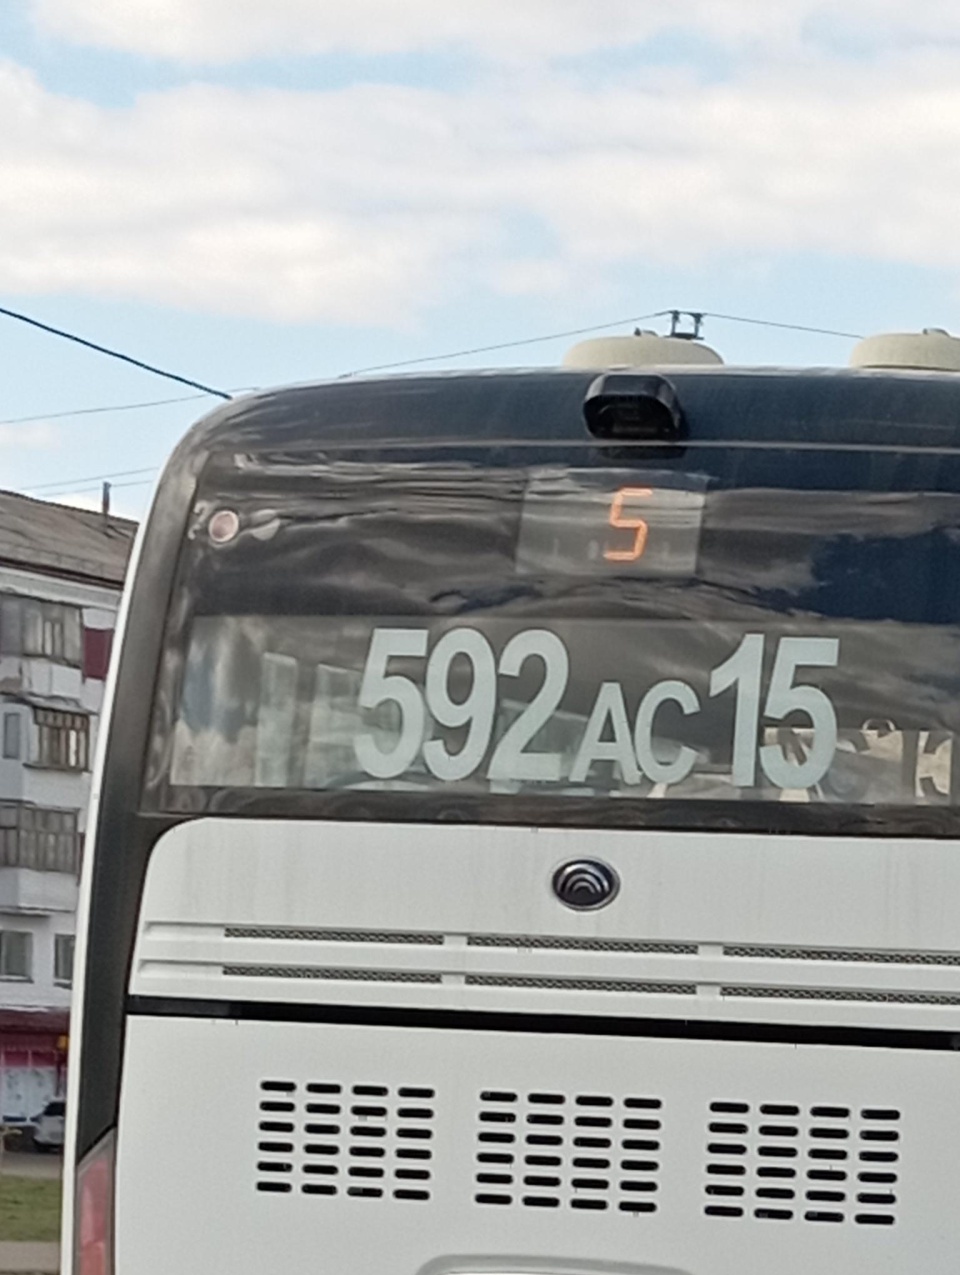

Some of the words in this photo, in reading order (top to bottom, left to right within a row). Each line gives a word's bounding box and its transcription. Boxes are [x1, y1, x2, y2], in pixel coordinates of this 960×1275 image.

[604, 487, 654, 561] 5
[354, 628, 569, 782] 592
[569, 680, 700, 786] AC
[709, 633, 840, 789] 15
